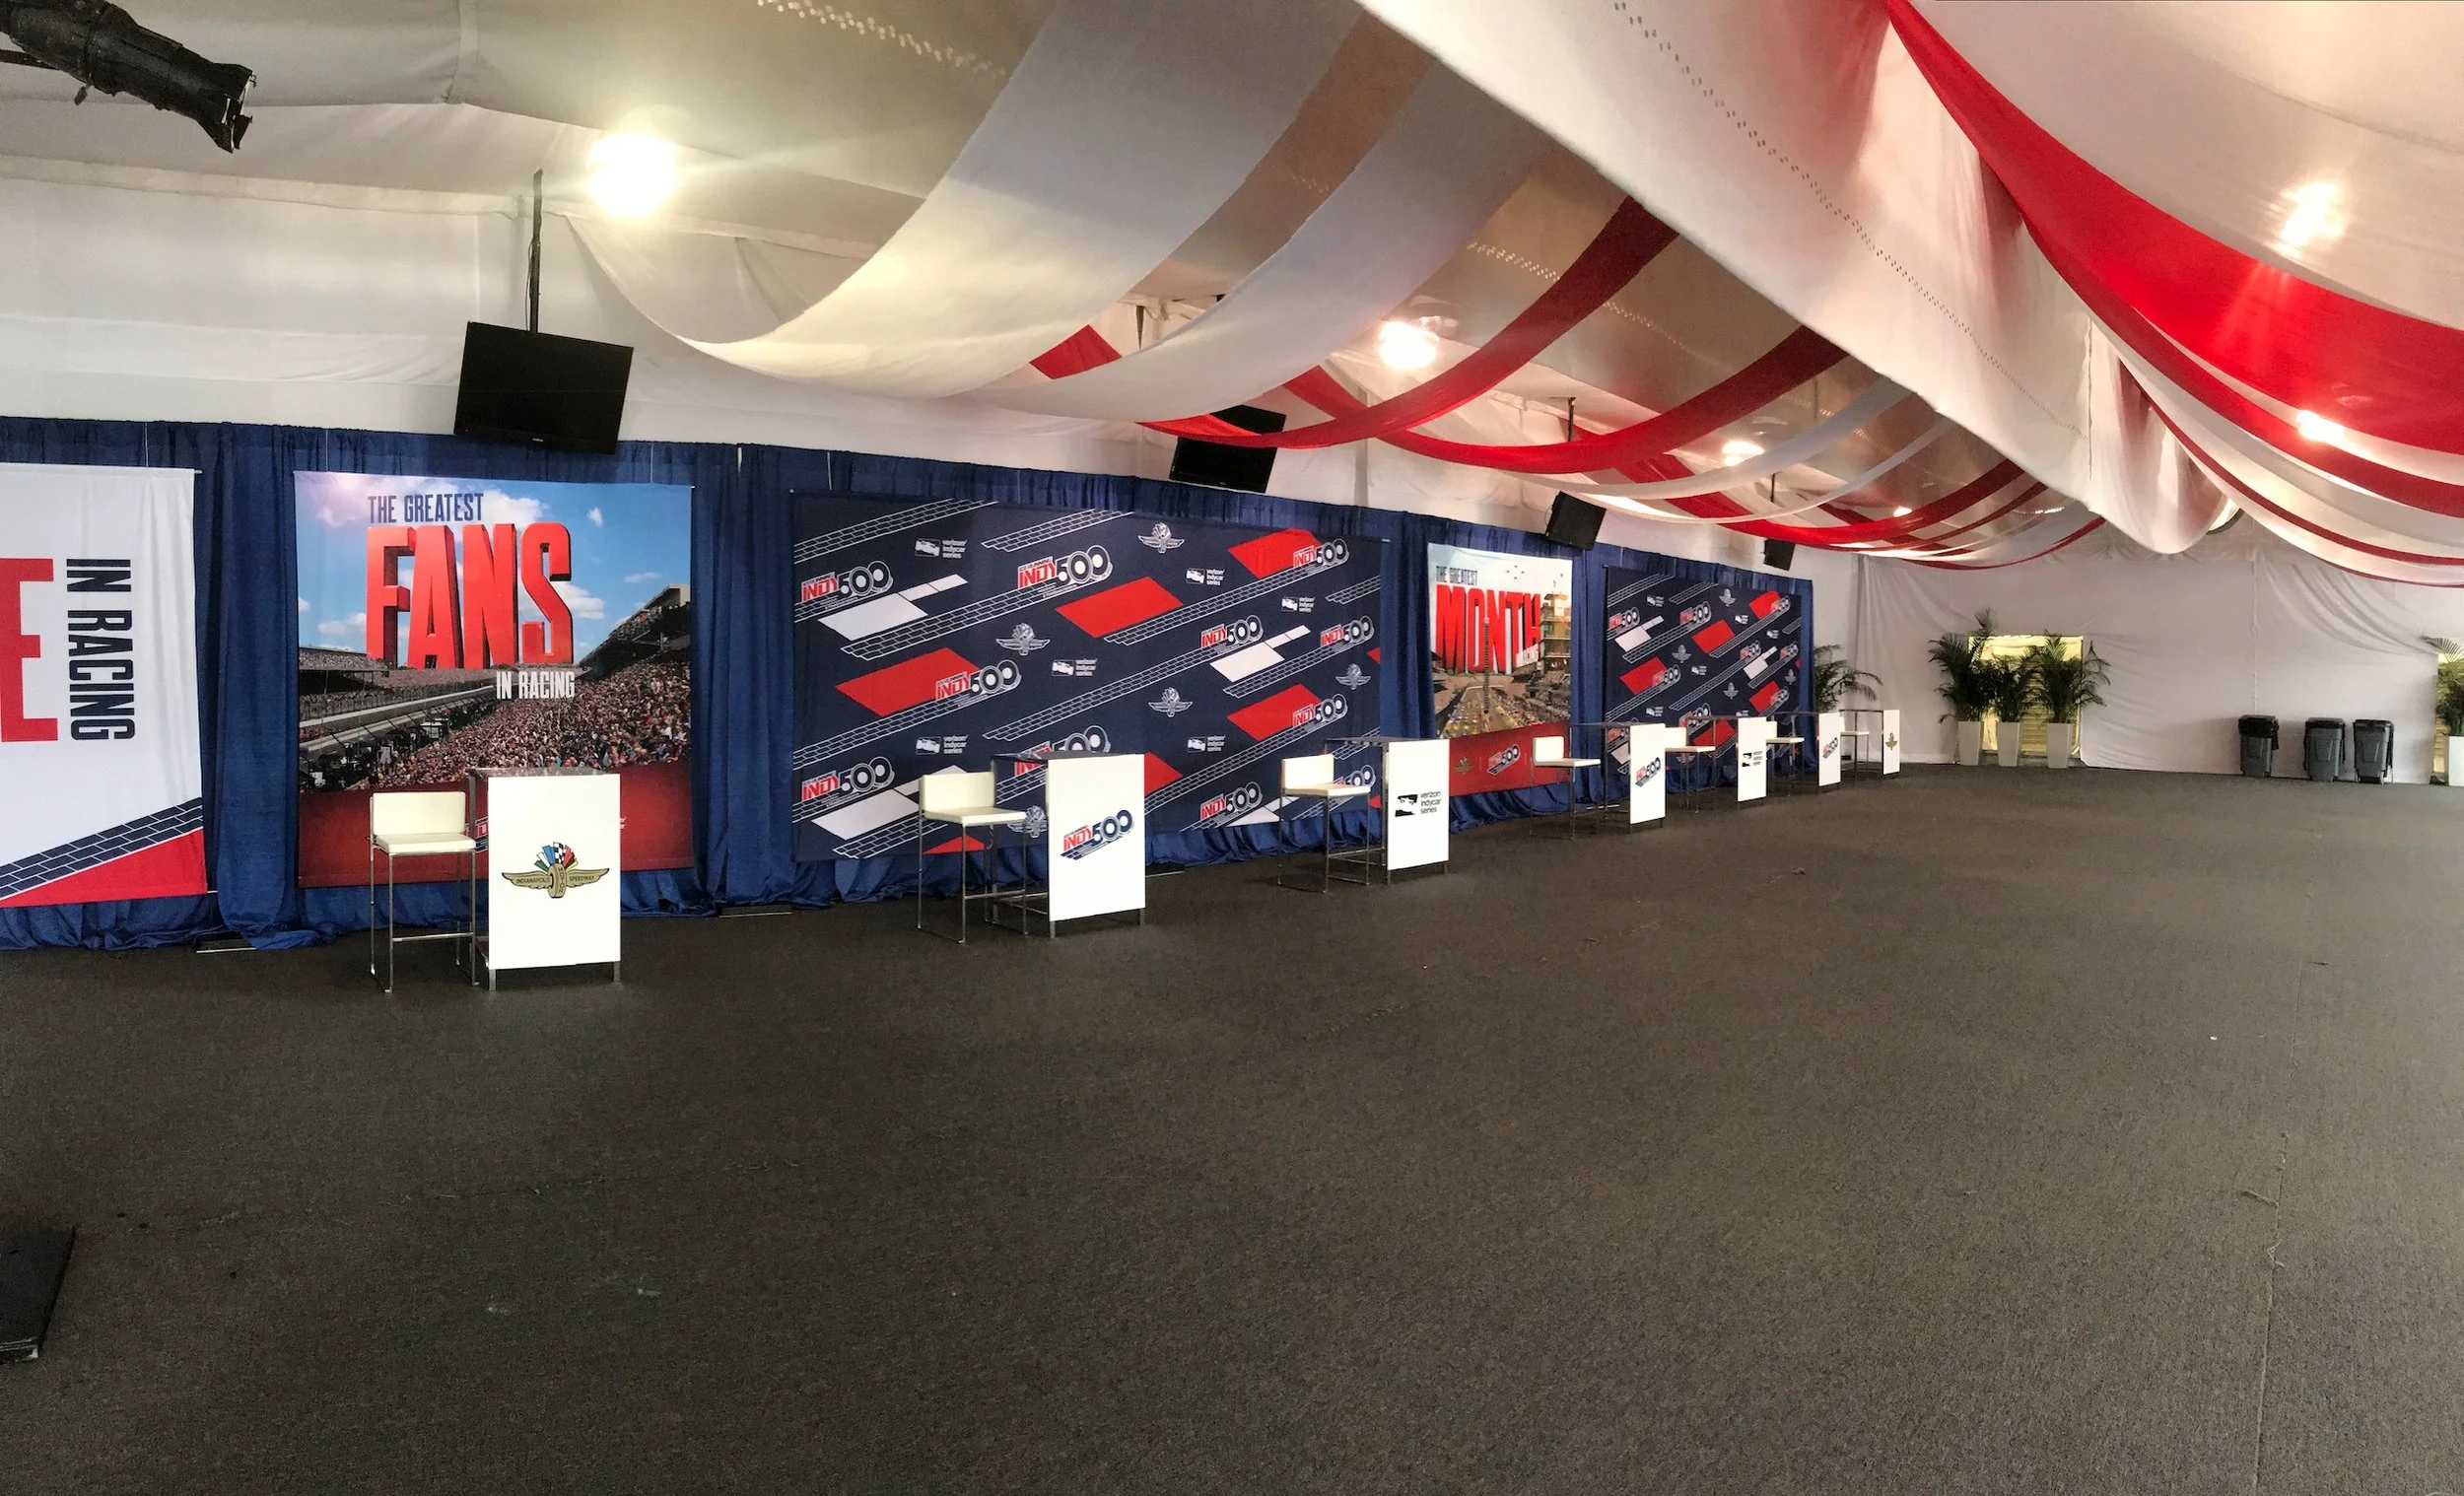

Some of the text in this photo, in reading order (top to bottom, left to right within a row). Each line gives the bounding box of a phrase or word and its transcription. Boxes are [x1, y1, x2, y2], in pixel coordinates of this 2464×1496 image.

[368, 493, 484, 523] THE GREATEST
[1019, 562, 1057, 589] INDY
[1057, 545, 1110, 585] 500
[1316, 538, 1347, 565] 500
[366, 522, 574, 669] FANS
[802, 577, 838, 602] INDY
[838, 561, 891, 597] 500
[1201, 615, 1263, 647] INDY 500
[1321, 616, 1373, 646] INDY 500
[1435, 583, 1540, 674] MONTH
[66, 559, 135, 740] IN RACING
[497, 671, 575, 699] IN RACING
[936, 676, 970, 701] INDY
[969, 659, 1020, 696] 500
[1293, 694, 1347, 727] INDY 500
[802, 775, 839, 800] INDY
[839, 756, 893, 794] 500
[1200, 796, 1226, 820] INDY
[1225, 782, 1262, 815] 500
[1063, 827, 1093, 851] INDY
[1092, 809, 1133, 847] 500
